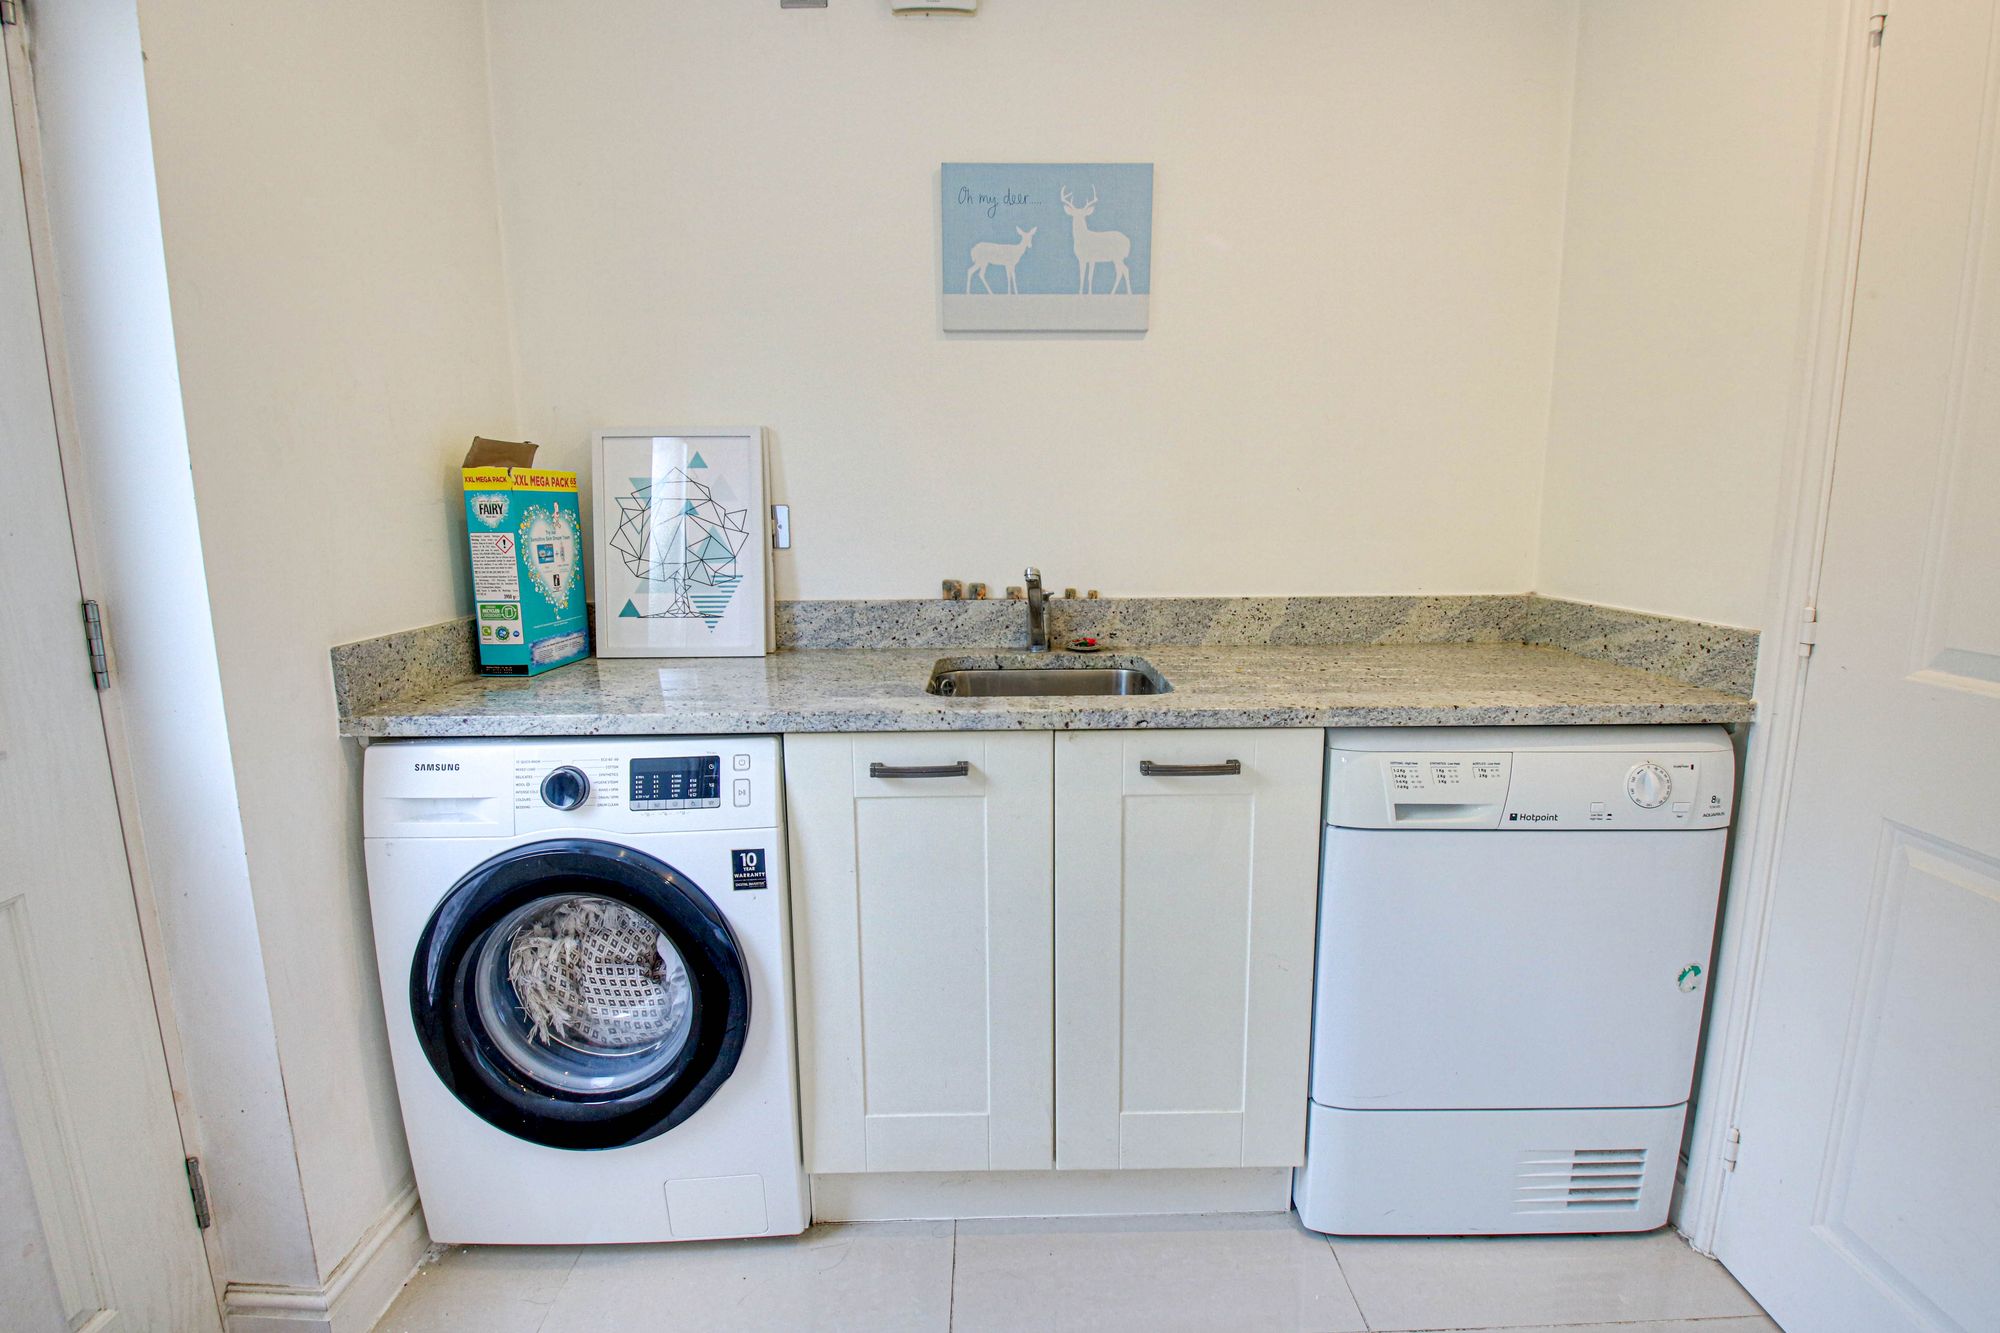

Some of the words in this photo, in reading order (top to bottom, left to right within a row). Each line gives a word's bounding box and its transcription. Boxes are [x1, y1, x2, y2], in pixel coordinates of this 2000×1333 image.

[958, 186, 974, 204] Oh
[979, 193, 998, 218] my
[514, 474, 528, 486] XXL
[530, 476, 550, 487] MEGA
[551, 476, 569, 488] PACK
[479, 503, 504, 515] FAIRY
[1711, 795, 1716, 803] 8
[1520, 814, 1558, 822] Hotpoint
[740, 852, 757, 867] 10
